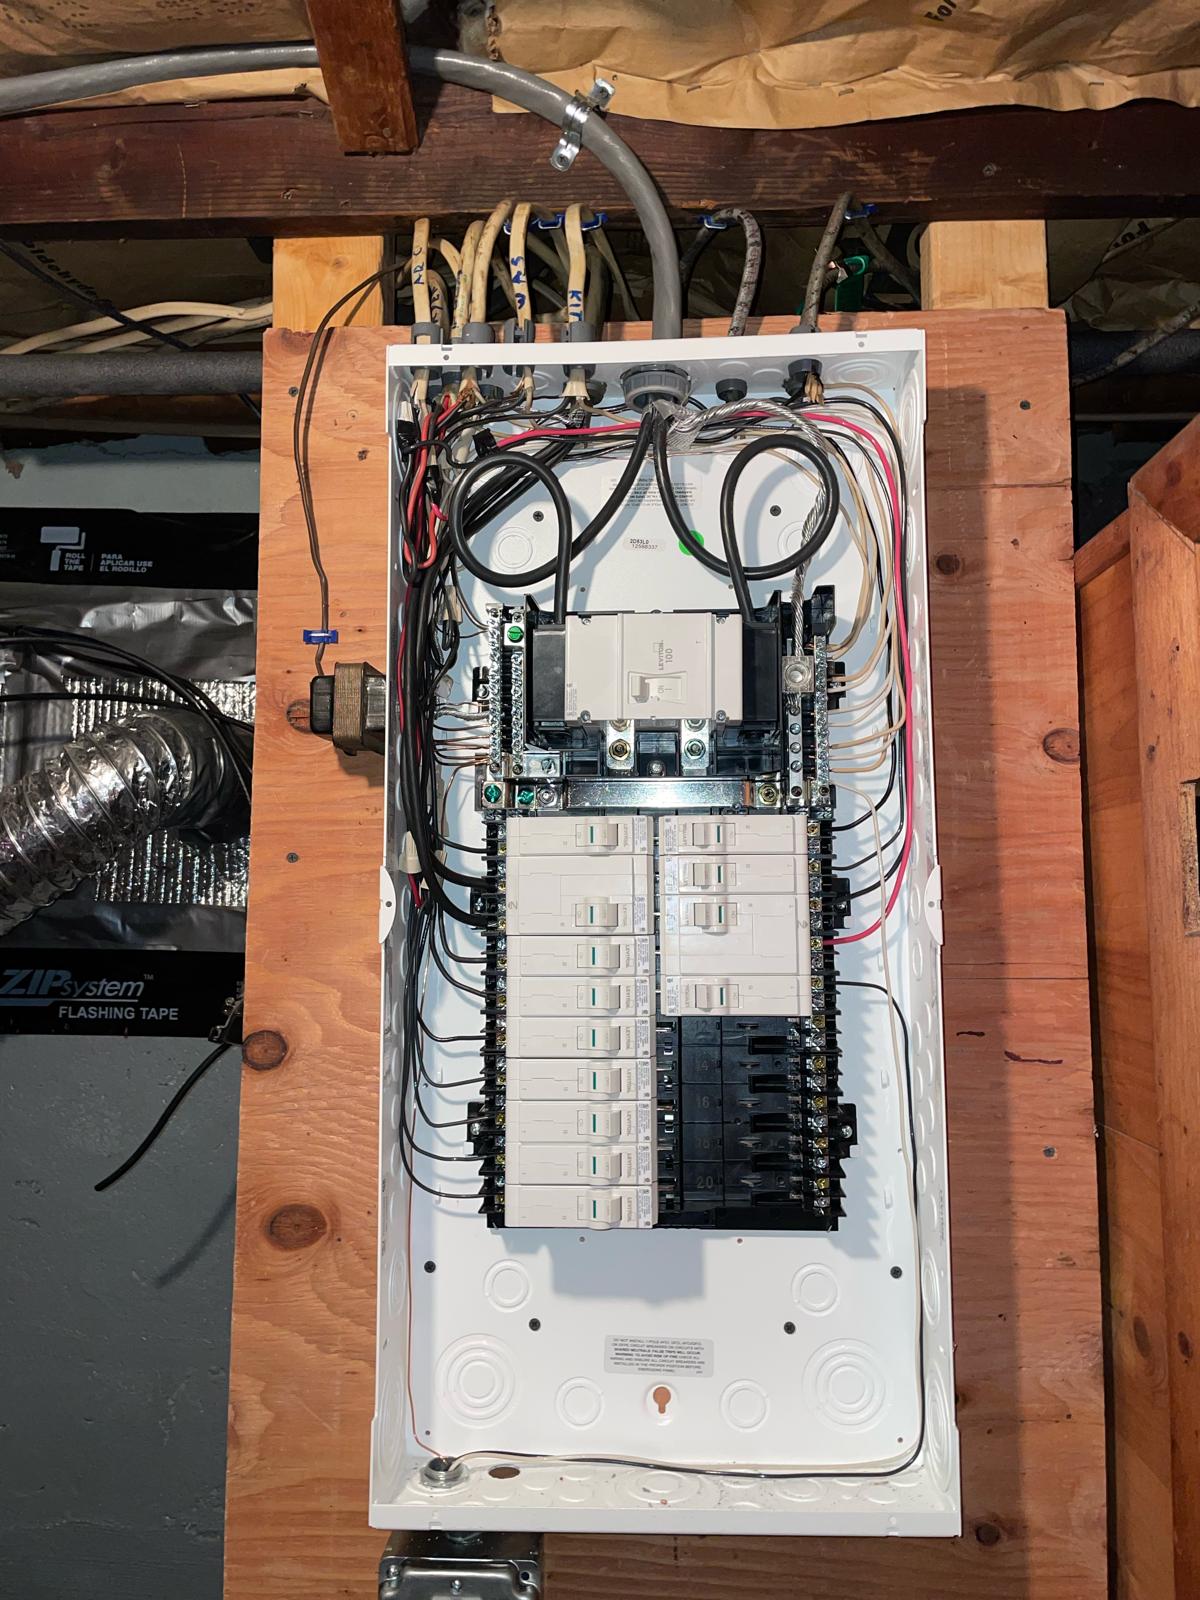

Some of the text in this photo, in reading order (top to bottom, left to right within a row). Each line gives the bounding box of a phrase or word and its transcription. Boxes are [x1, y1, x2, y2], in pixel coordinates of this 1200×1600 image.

[568, 290, 583, 322] KIT
[58, 1006, 178, 1020] FLASHING TAPE
[696, 1176, 714, 1189] 20
